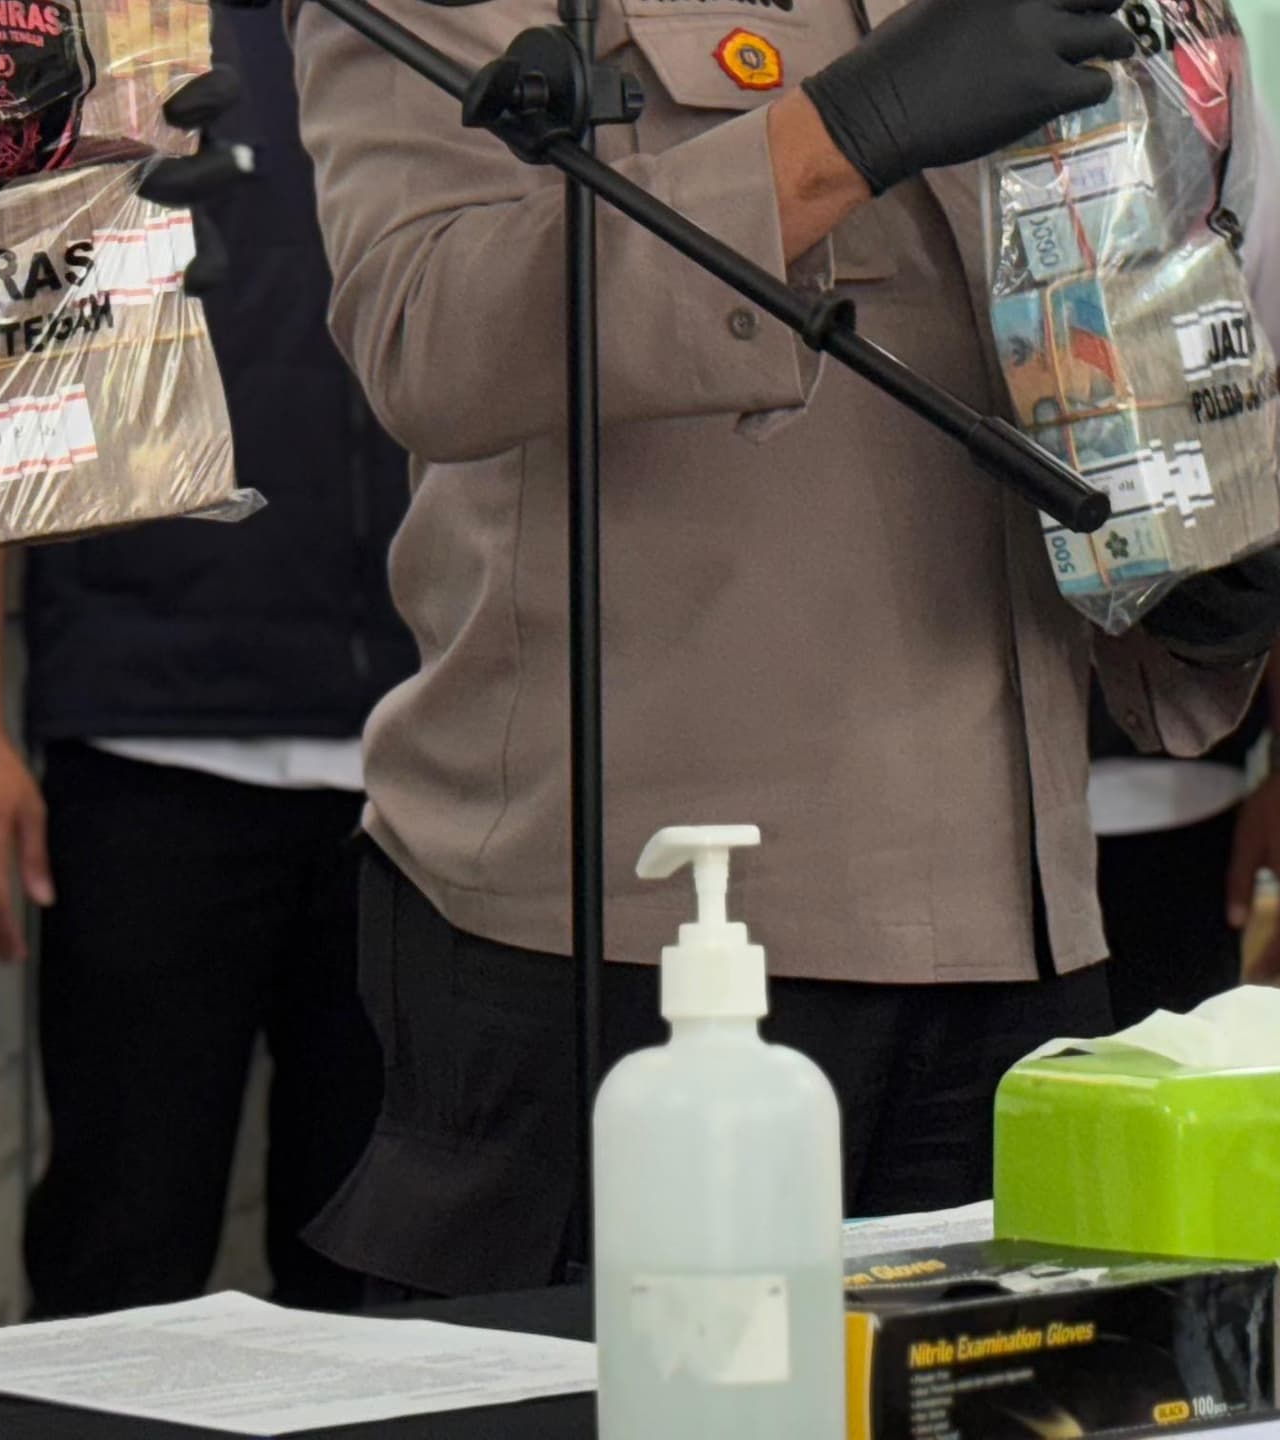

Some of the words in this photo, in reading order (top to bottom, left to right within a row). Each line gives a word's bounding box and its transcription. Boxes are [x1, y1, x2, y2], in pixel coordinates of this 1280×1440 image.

[909, 1339, 955, 1368] Nitrile
[957, 1328, 1043, 1360] Examination
[1047, 1322, 1096, 1346] Gloves
